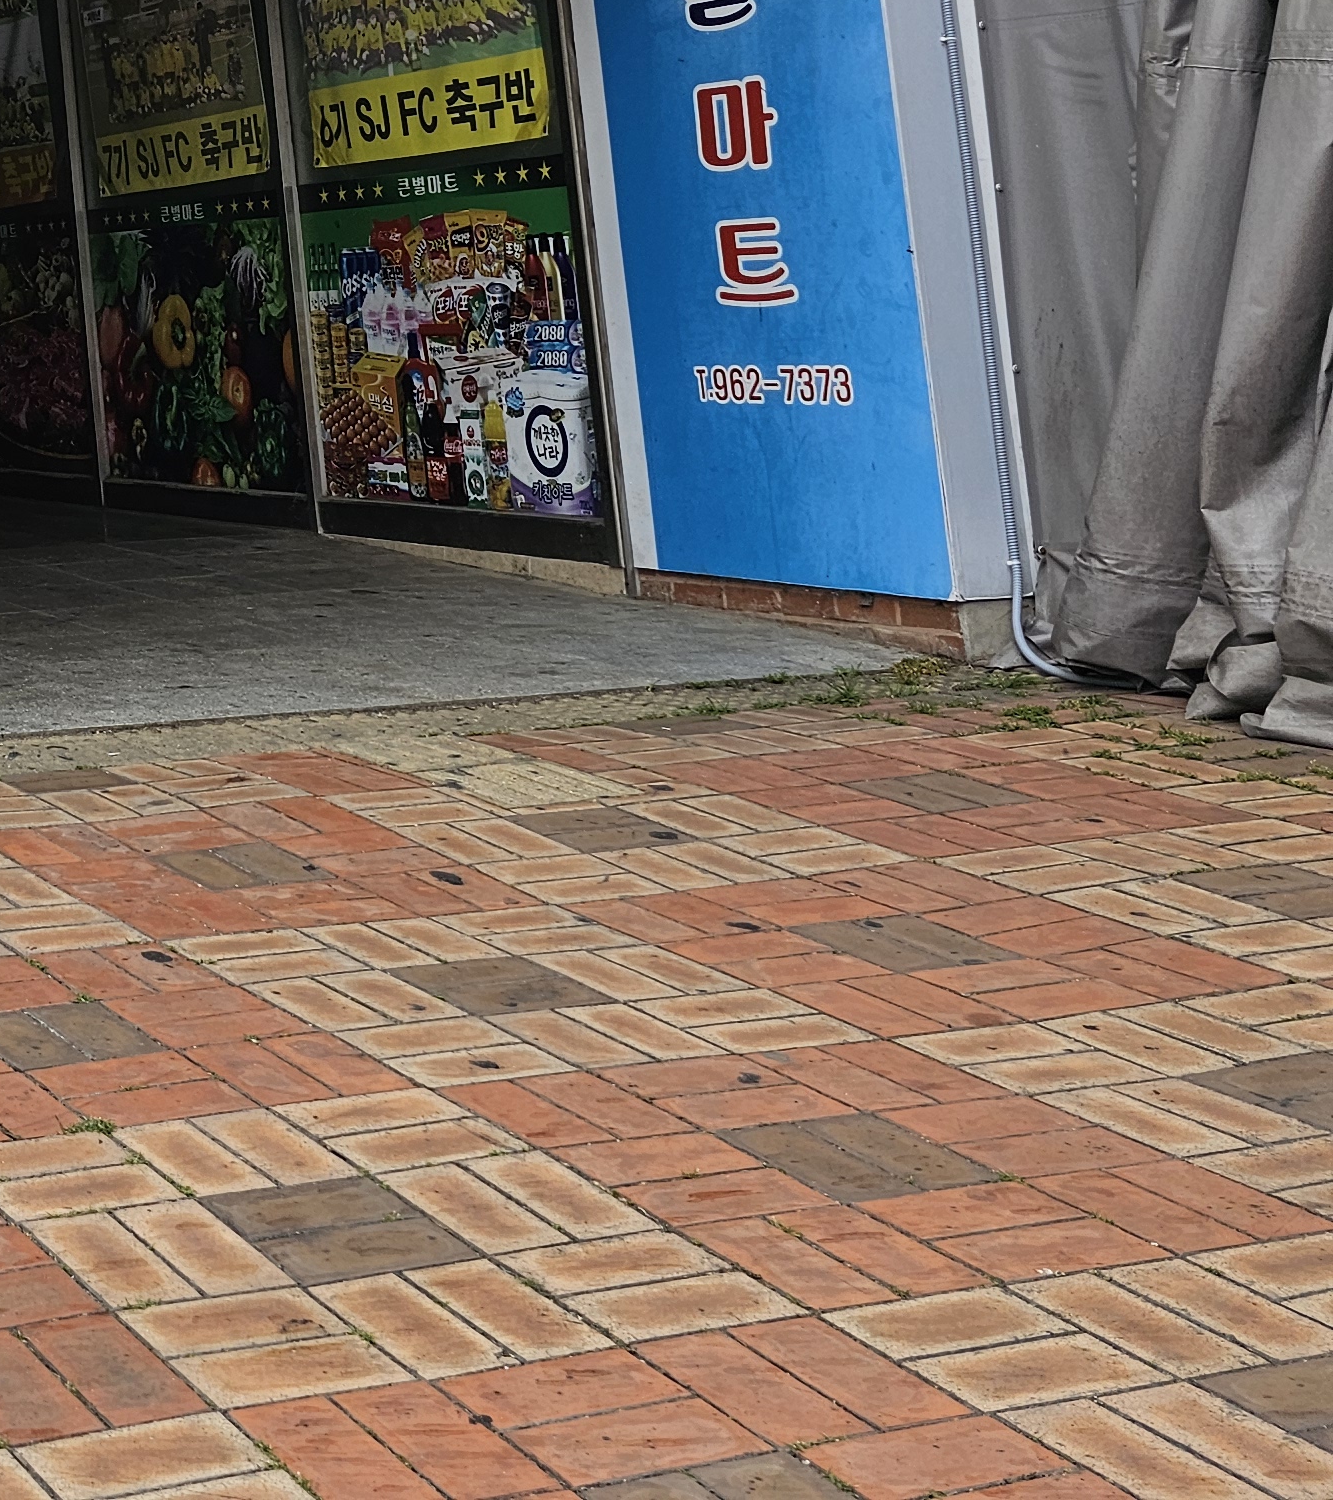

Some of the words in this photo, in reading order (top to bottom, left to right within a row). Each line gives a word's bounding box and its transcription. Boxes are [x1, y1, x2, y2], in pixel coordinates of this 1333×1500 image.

[319, 100, 352, 149] 6기
[355, 94, 391, 143] SJ
[397, 86, 438, 137] FC
[445, 67, 537, 132] 축구반
[101, 139, 131, 186] 7기
[135, 136, 160, 180] SJ
[160, 130, 193, 175] FC
[198, 113, 264, 172] 축구반
[396, 172, 460, 198] 큰별마트
[159, 202, 206, 224] 큰별마트
[533, 325, 565, 342] 2080
[536, 351, 568, 368] 2080
[694, 365, 854, 408] T.962-7373
[537, 442, 561, 461] 나라
